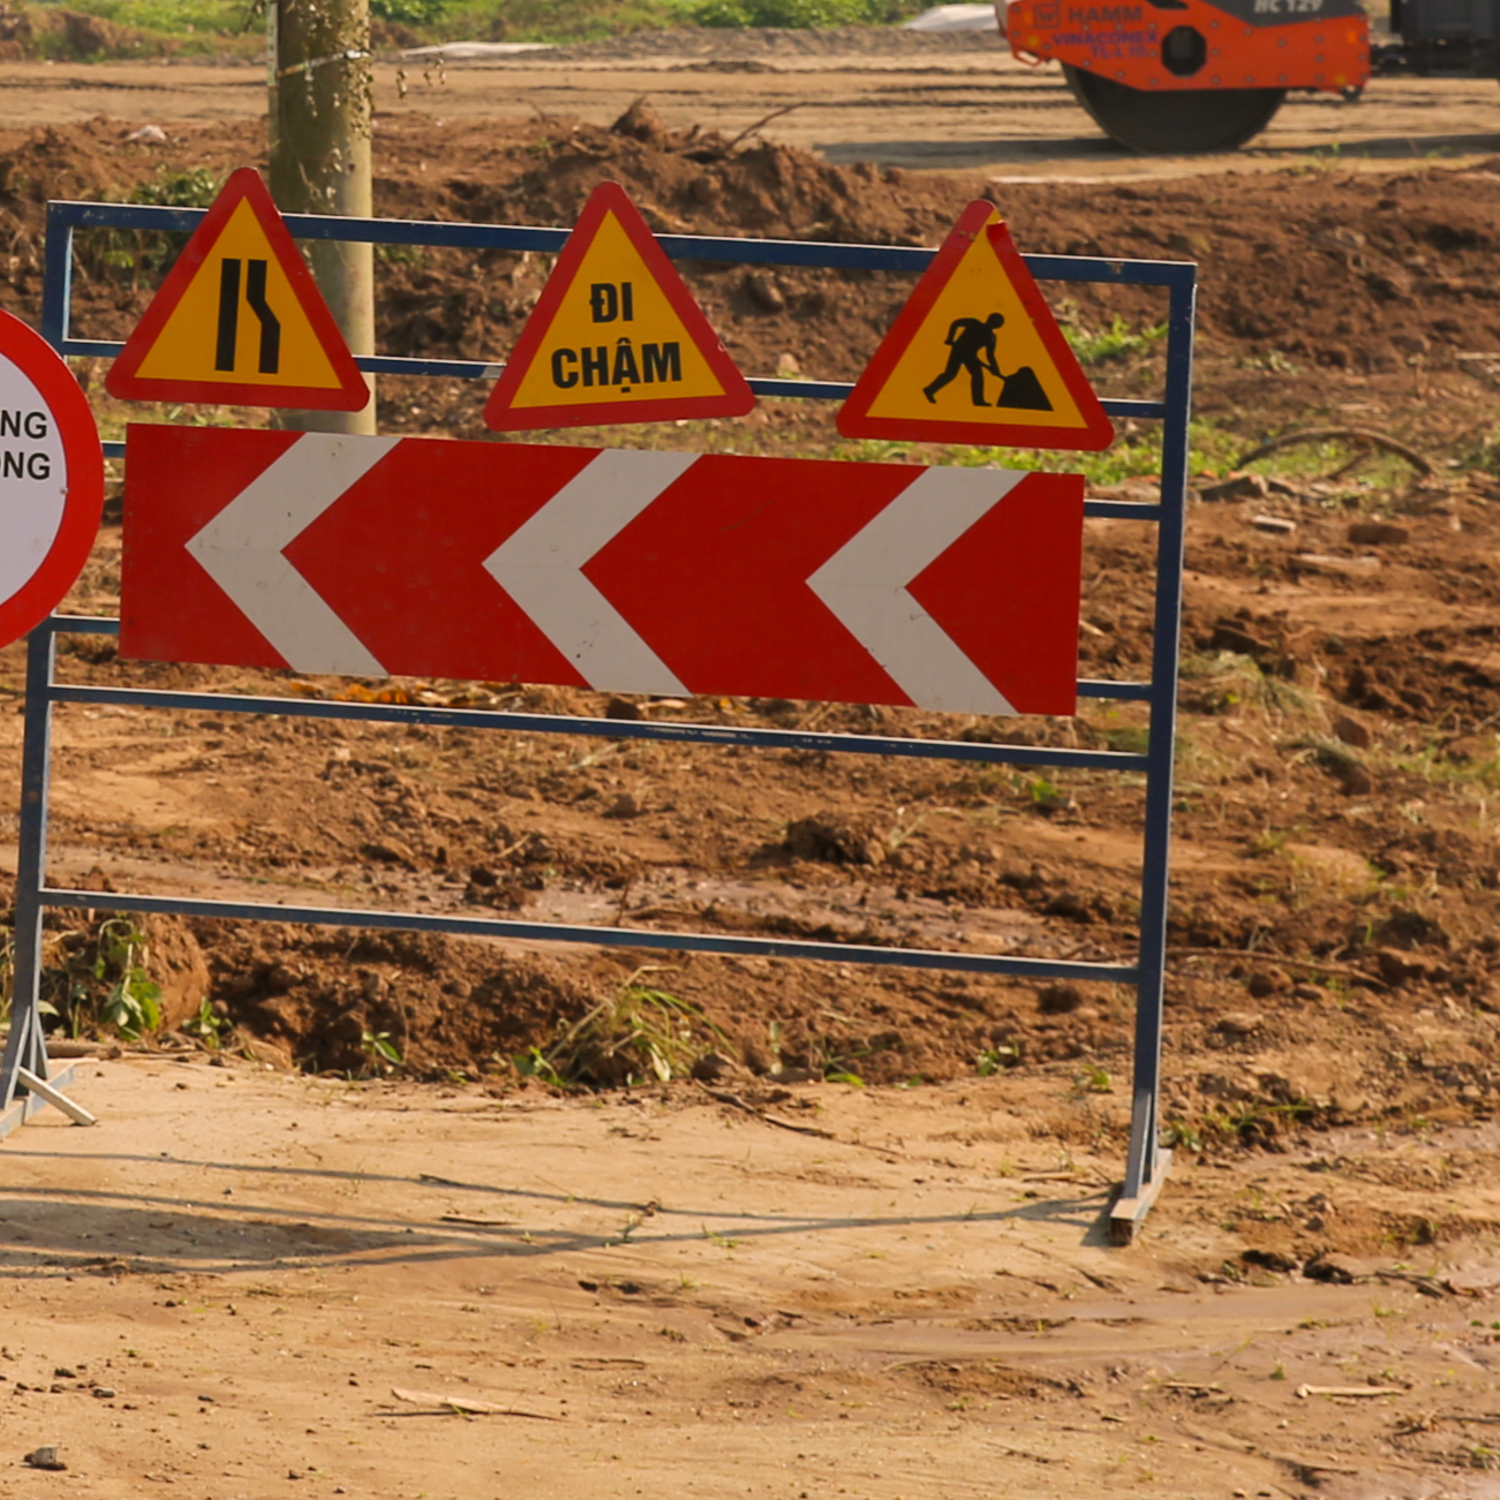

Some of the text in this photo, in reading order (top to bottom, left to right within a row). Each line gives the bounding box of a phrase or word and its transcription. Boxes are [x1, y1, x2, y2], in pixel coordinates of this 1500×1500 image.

[1068, 5, 1143, 23] HAMM
[589, 281, 634, 323] ĐI
[550, 336, 683, 394] CHẬM
